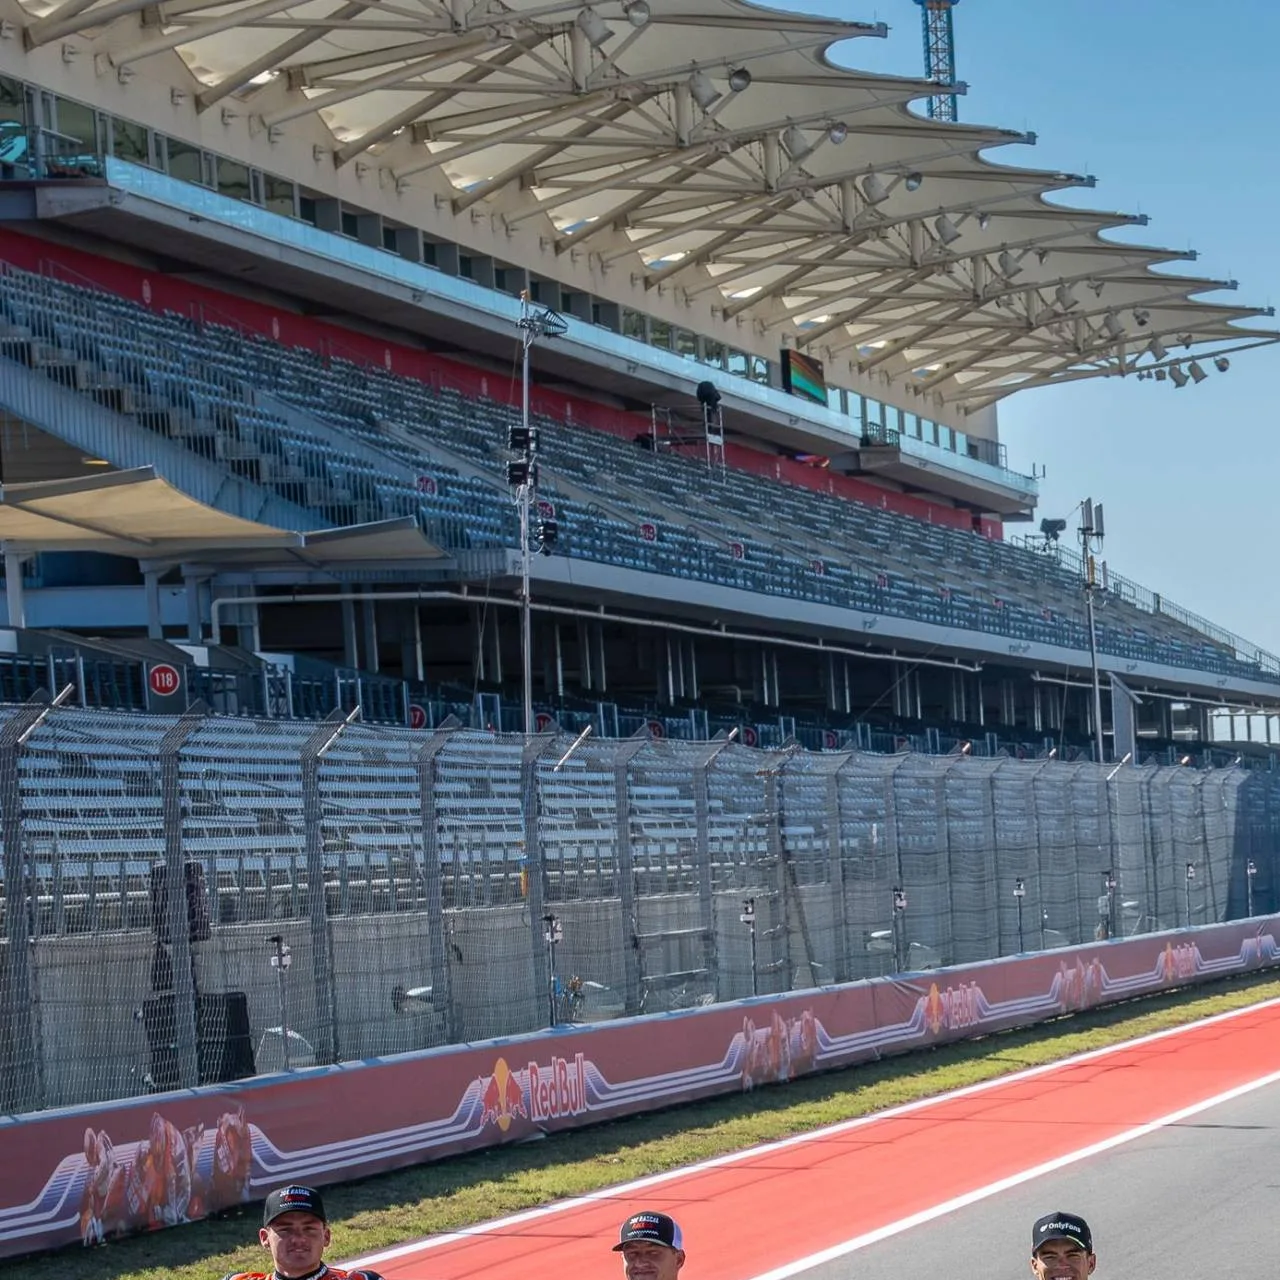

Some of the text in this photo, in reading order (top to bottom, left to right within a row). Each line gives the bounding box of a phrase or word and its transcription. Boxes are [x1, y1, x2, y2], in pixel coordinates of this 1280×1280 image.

[154, 673, 173, 688] 118
[529, 1054, 586, 1121] Red Bull
[1048, 1222, 1081, 1232] OnlyFans
